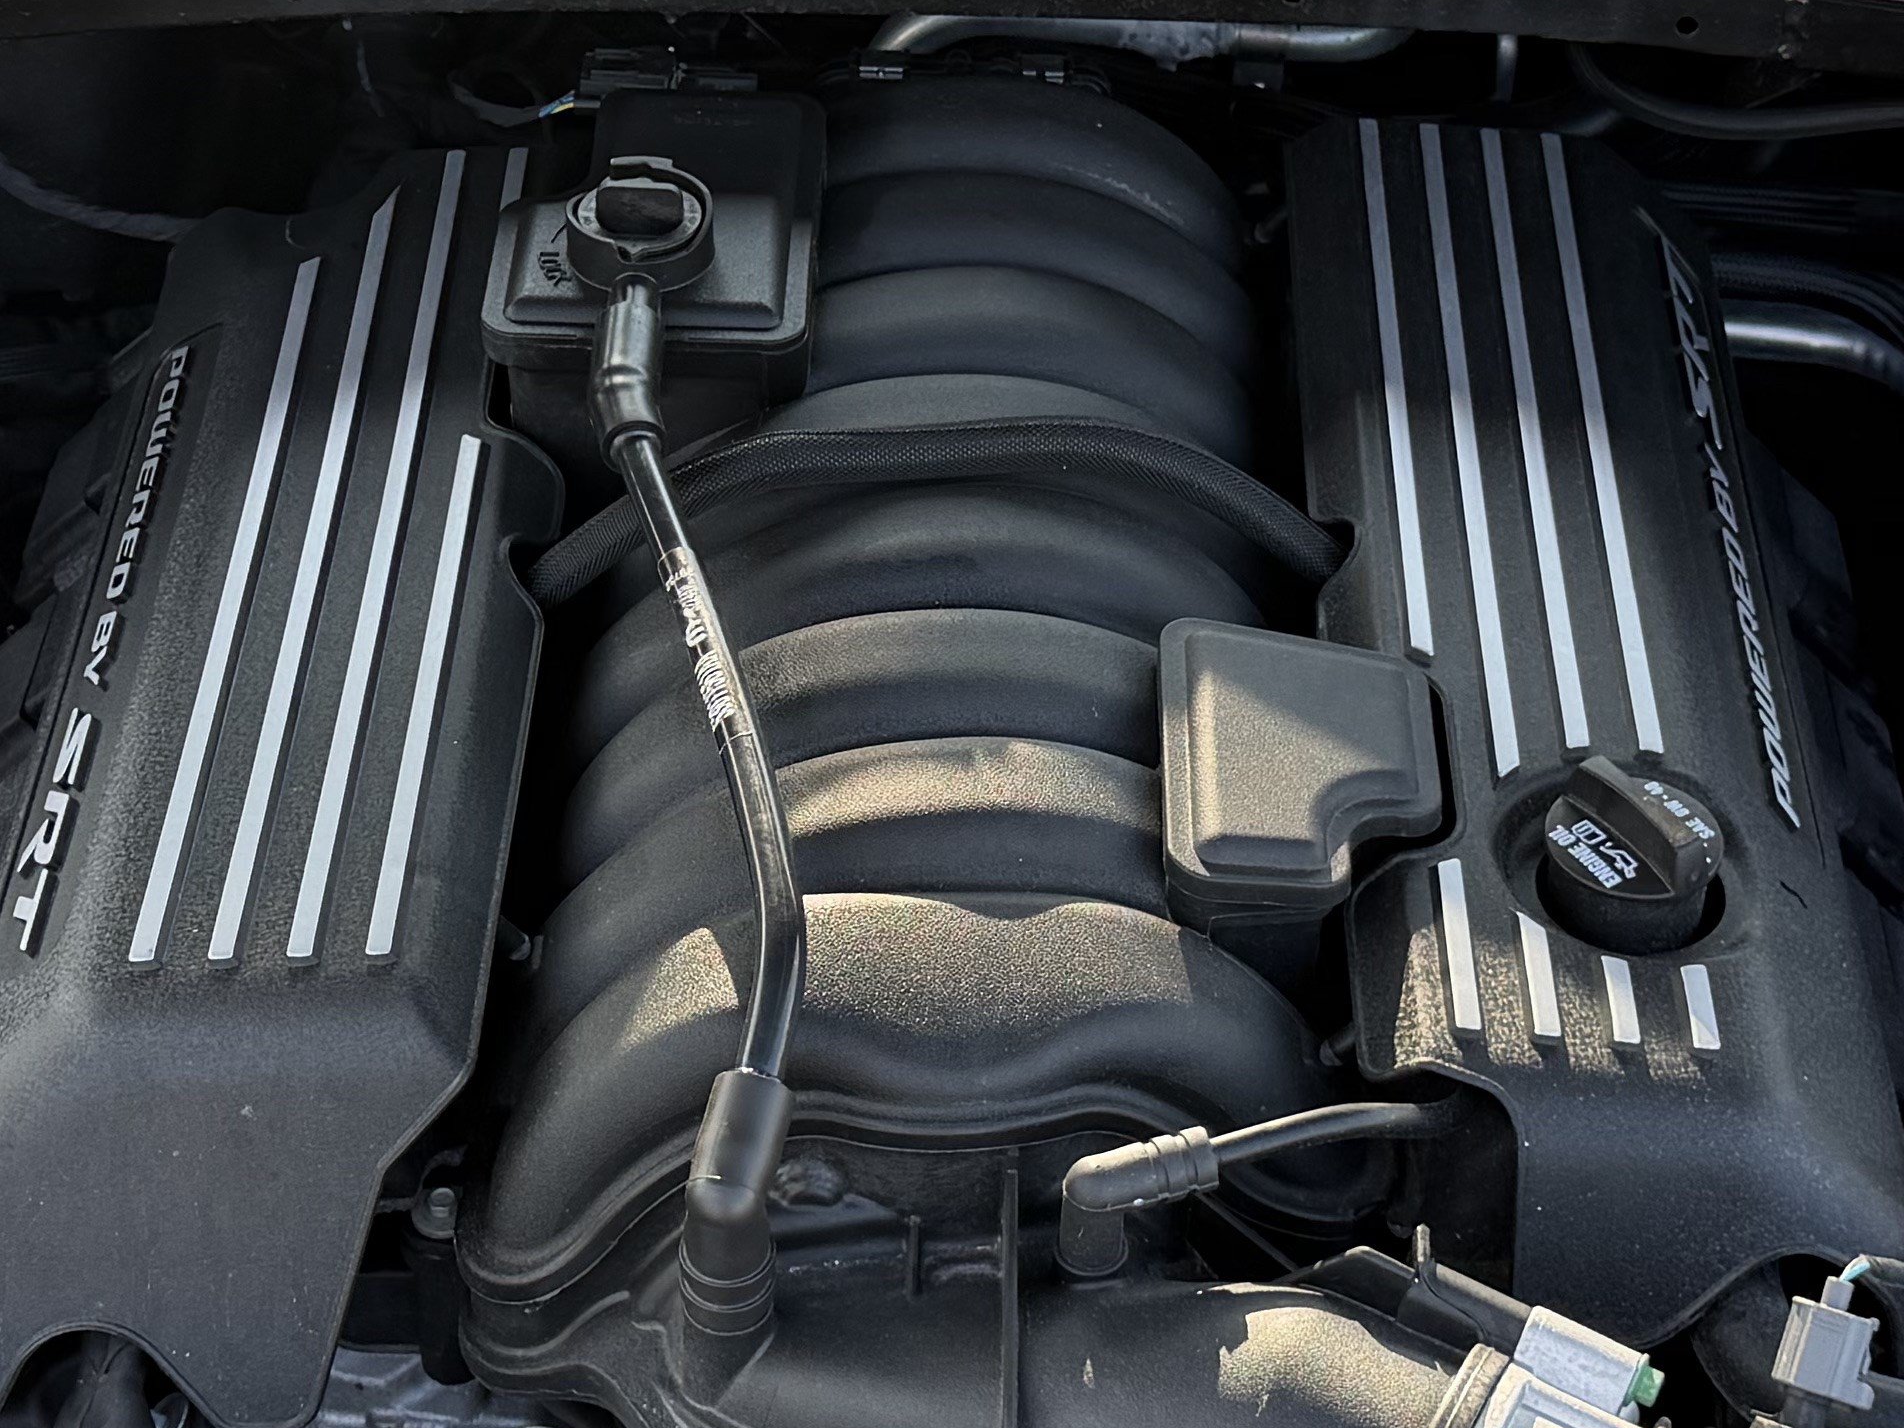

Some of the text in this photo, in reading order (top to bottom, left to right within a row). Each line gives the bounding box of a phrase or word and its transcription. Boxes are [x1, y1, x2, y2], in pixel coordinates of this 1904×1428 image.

[11, 345, 190, 953] POWERED BY SRT
[1662, 233, 1804, 829] POWERED BY SRT
[1547, 824, 1624, 890] ENGINE OIL
[1684, 816, 1717, 841] SAE
